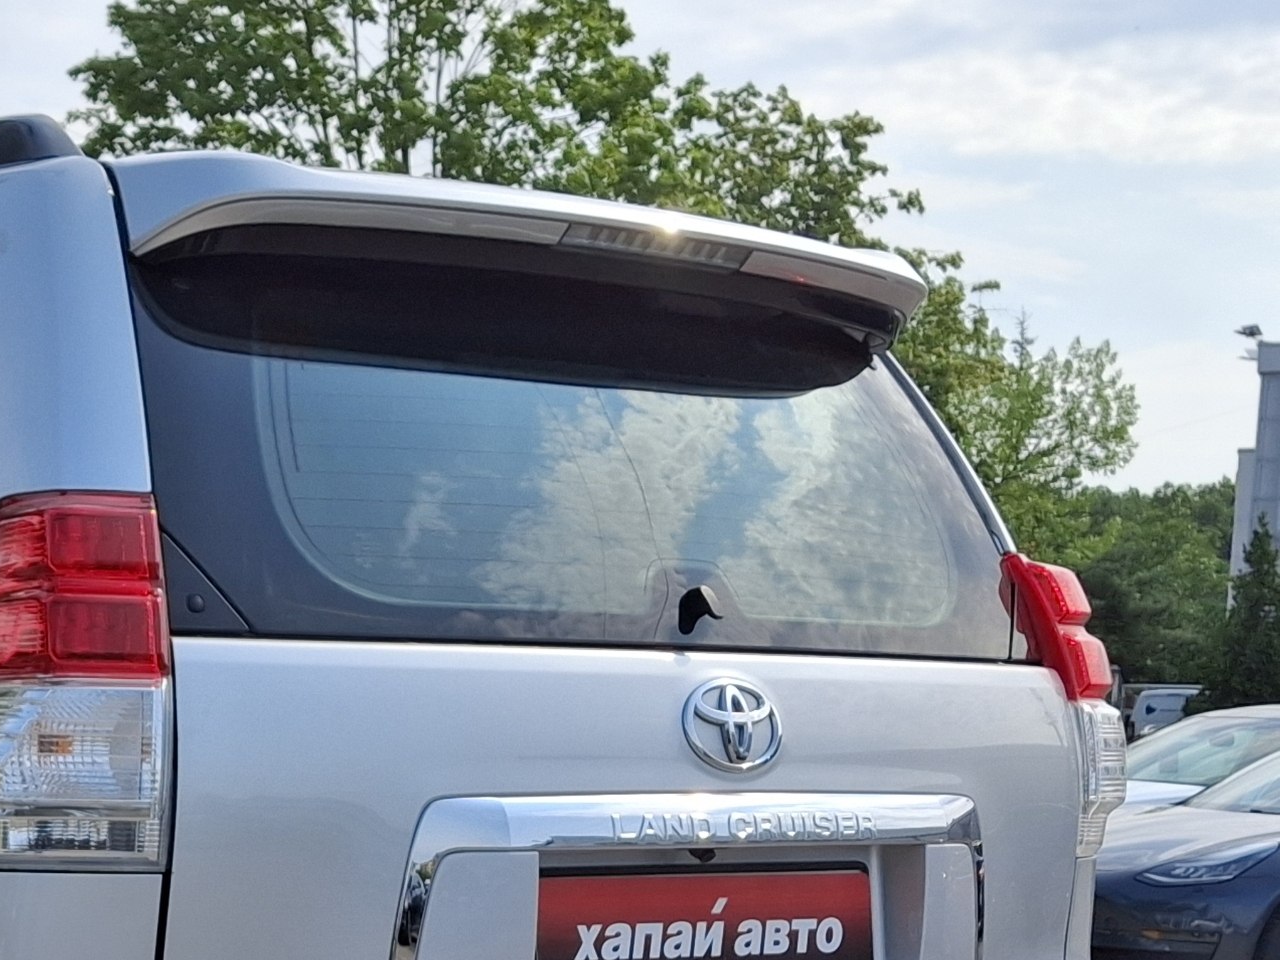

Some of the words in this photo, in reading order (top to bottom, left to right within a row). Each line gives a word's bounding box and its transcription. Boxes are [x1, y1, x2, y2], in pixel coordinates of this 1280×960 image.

[611, 812, 717, 841] LAND
[728, 812, 878, 840] CRUISER
[734, 917, 844, 957] авто
